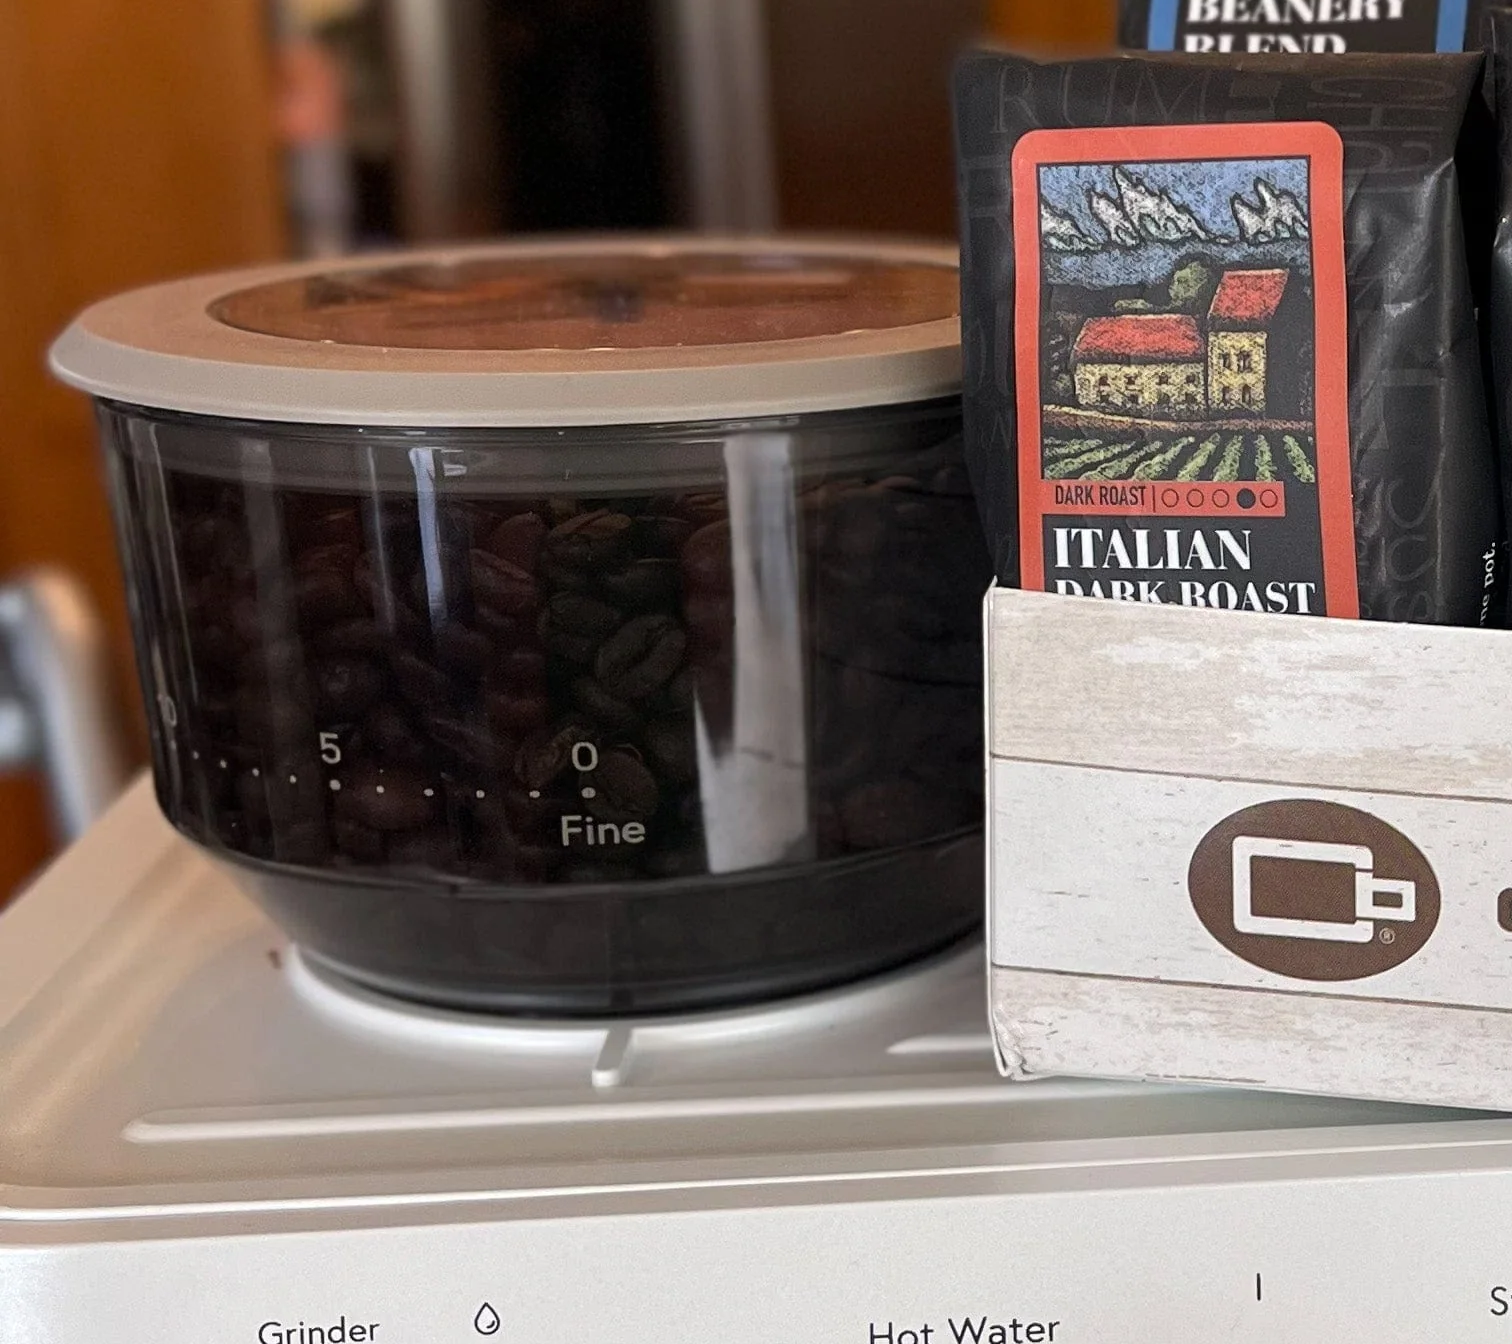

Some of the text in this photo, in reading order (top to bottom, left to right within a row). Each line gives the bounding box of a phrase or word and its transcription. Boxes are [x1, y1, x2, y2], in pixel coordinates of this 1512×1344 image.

[1055, 484, 1147, 506] DARK ROAST
[1052, 526, 1251, 570] ITALIAN
[1179, 580, 1315, 614] ROAST
[319, 732, 341, 764] 5
[571, 741, 598, 772] 0
[561, 815, 645, 846] Fine
